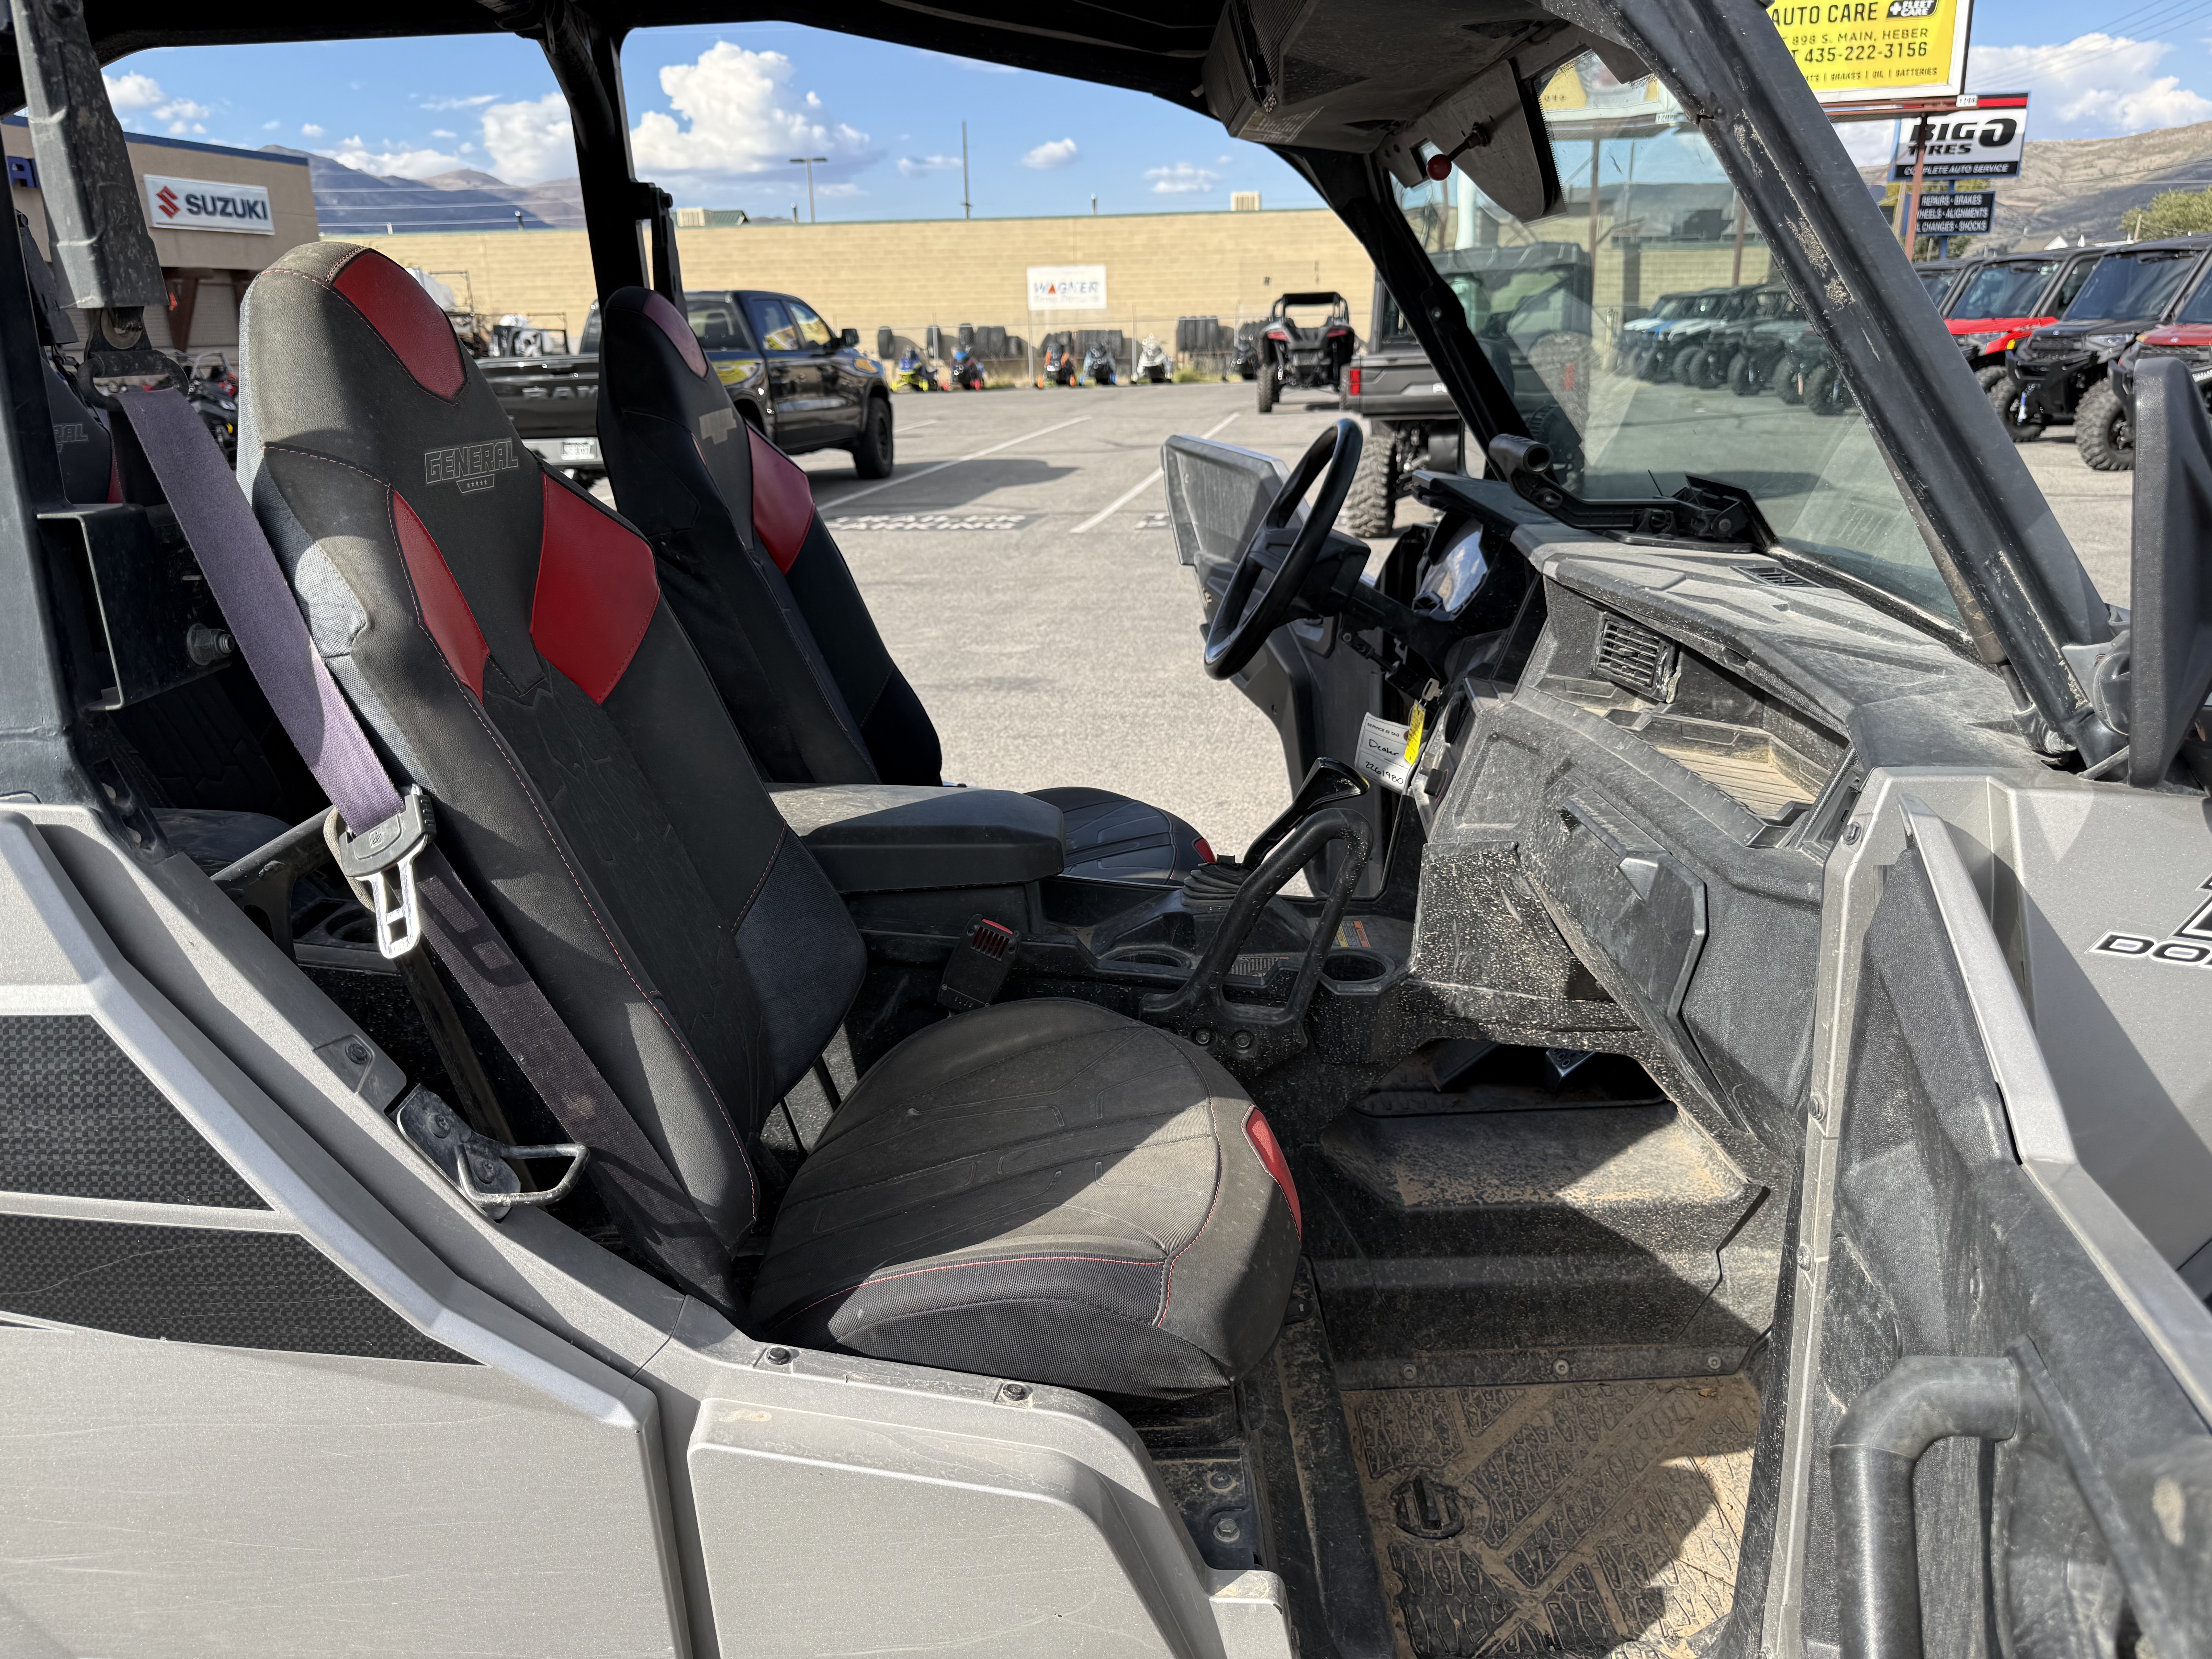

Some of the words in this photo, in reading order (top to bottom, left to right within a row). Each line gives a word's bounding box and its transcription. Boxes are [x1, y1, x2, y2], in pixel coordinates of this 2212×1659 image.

[1902, 0, 1934, 9] FLEET
[1772, 6, 1819, 26] AUTO
[1828, 1, 1878, 23] CARE
[1900, 8, 1929, 17] CARE
[1882, 28, 1928, 40] HEBER
[1804, 41, 1927, 63] 435-222-3156
[1831, 72, 1860, 81] BRAKES
[1896, 67, 1937, 77] BATTERIES
[1910, 122, 1977, 141] BIG
[1904, 167, 1949, 175] COPLETE
[1948, 164, 1972, 174] AUTO
[1973, 163, 2009, 173] SERVICE
[1921, 195, 1951, 206] REPAIRS
[1954, 194, 1983, 206] BRAKES
[185, 194, 268, 220] SUZUKI
[1945, 207, 1989, 219] ALIGNMENTS
[1922, 220, 1955, 232] CHANGES
[1958, 220, 1988, 232] SHOCKS
[424, 438, 519, 484] GENERAL
[1367, 722, 1384, 733] SERVICE
[1369, 738, 1399, 756] Dealer
[1365, 761, 1403, 784] 2261980
